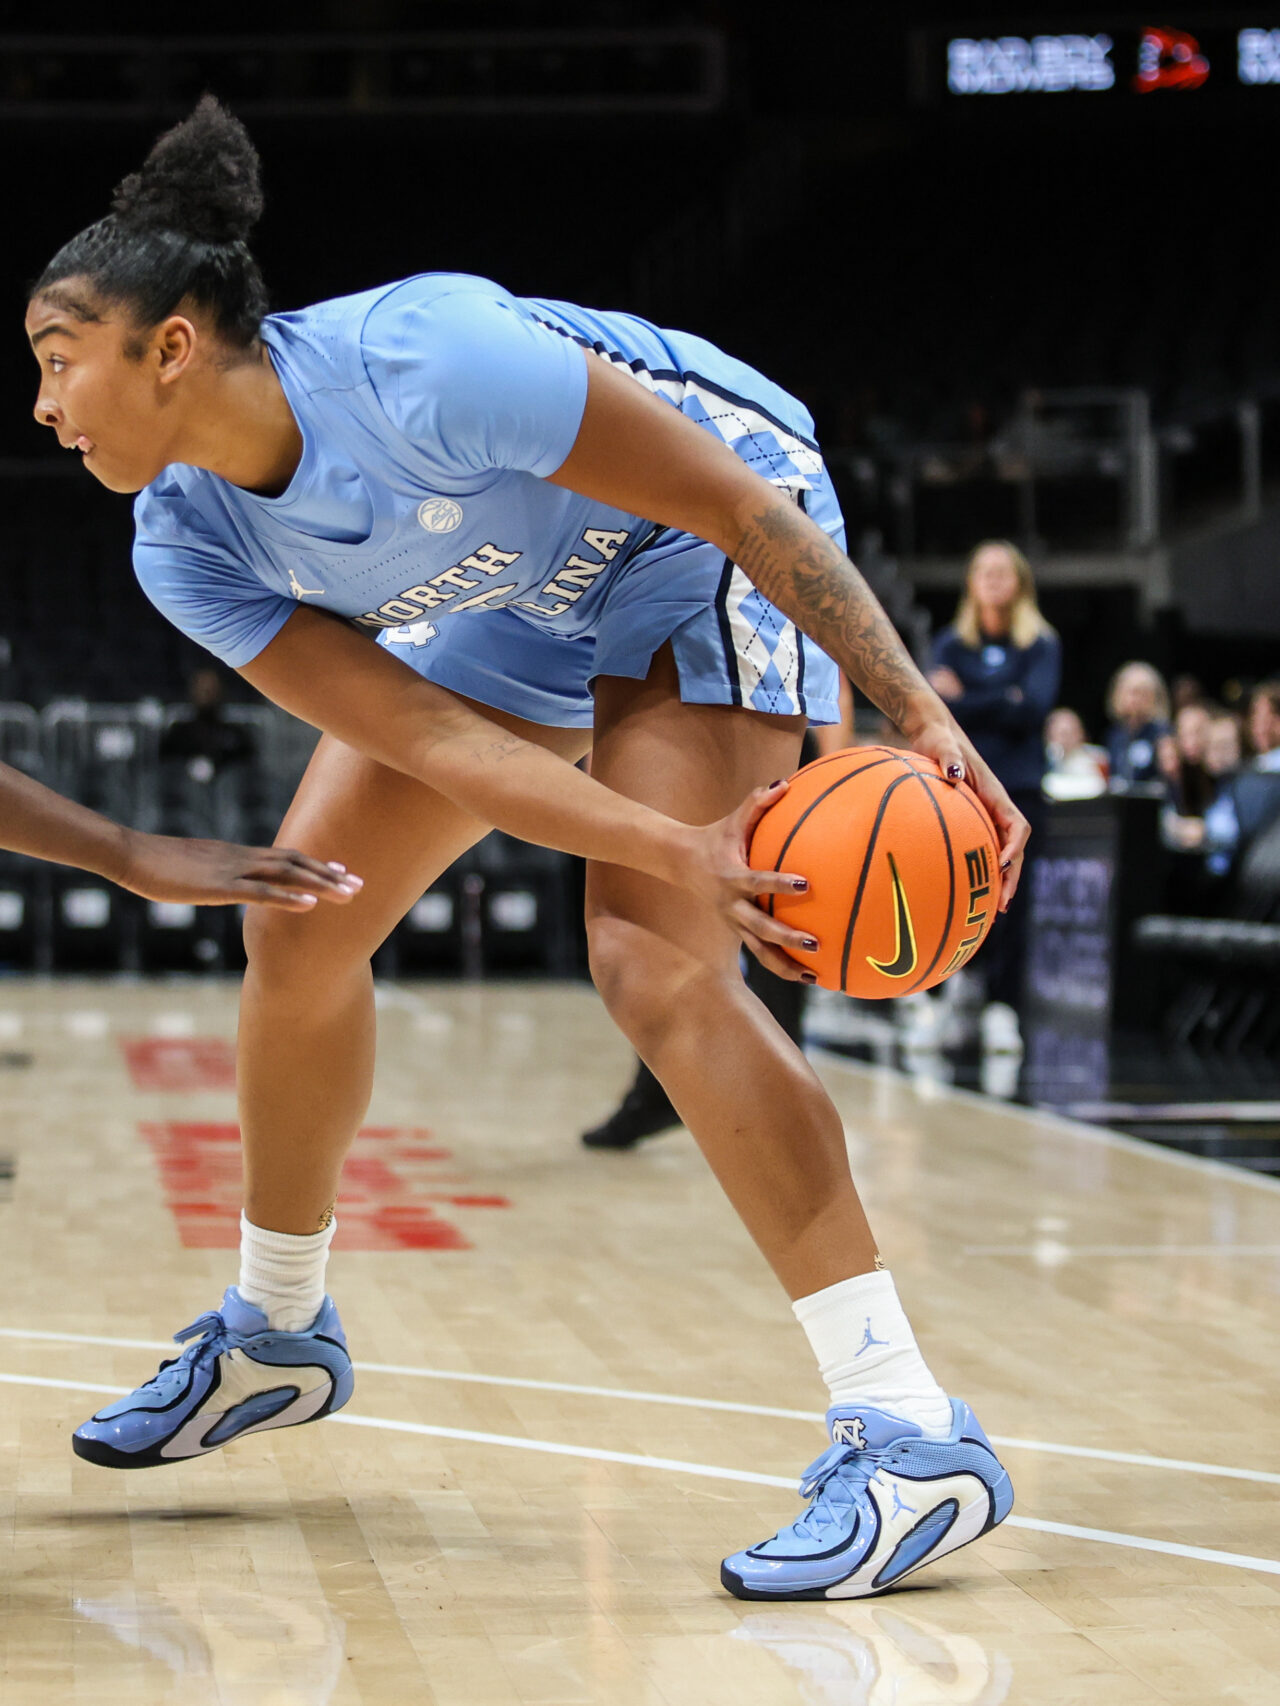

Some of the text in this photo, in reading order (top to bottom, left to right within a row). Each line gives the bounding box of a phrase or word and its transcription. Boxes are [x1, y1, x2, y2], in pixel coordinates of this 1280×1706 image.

[352, 541, 523, 628] NORTH
[519, 526, 631, 617] LINA
[938, 846, 991, 977] ELITE
